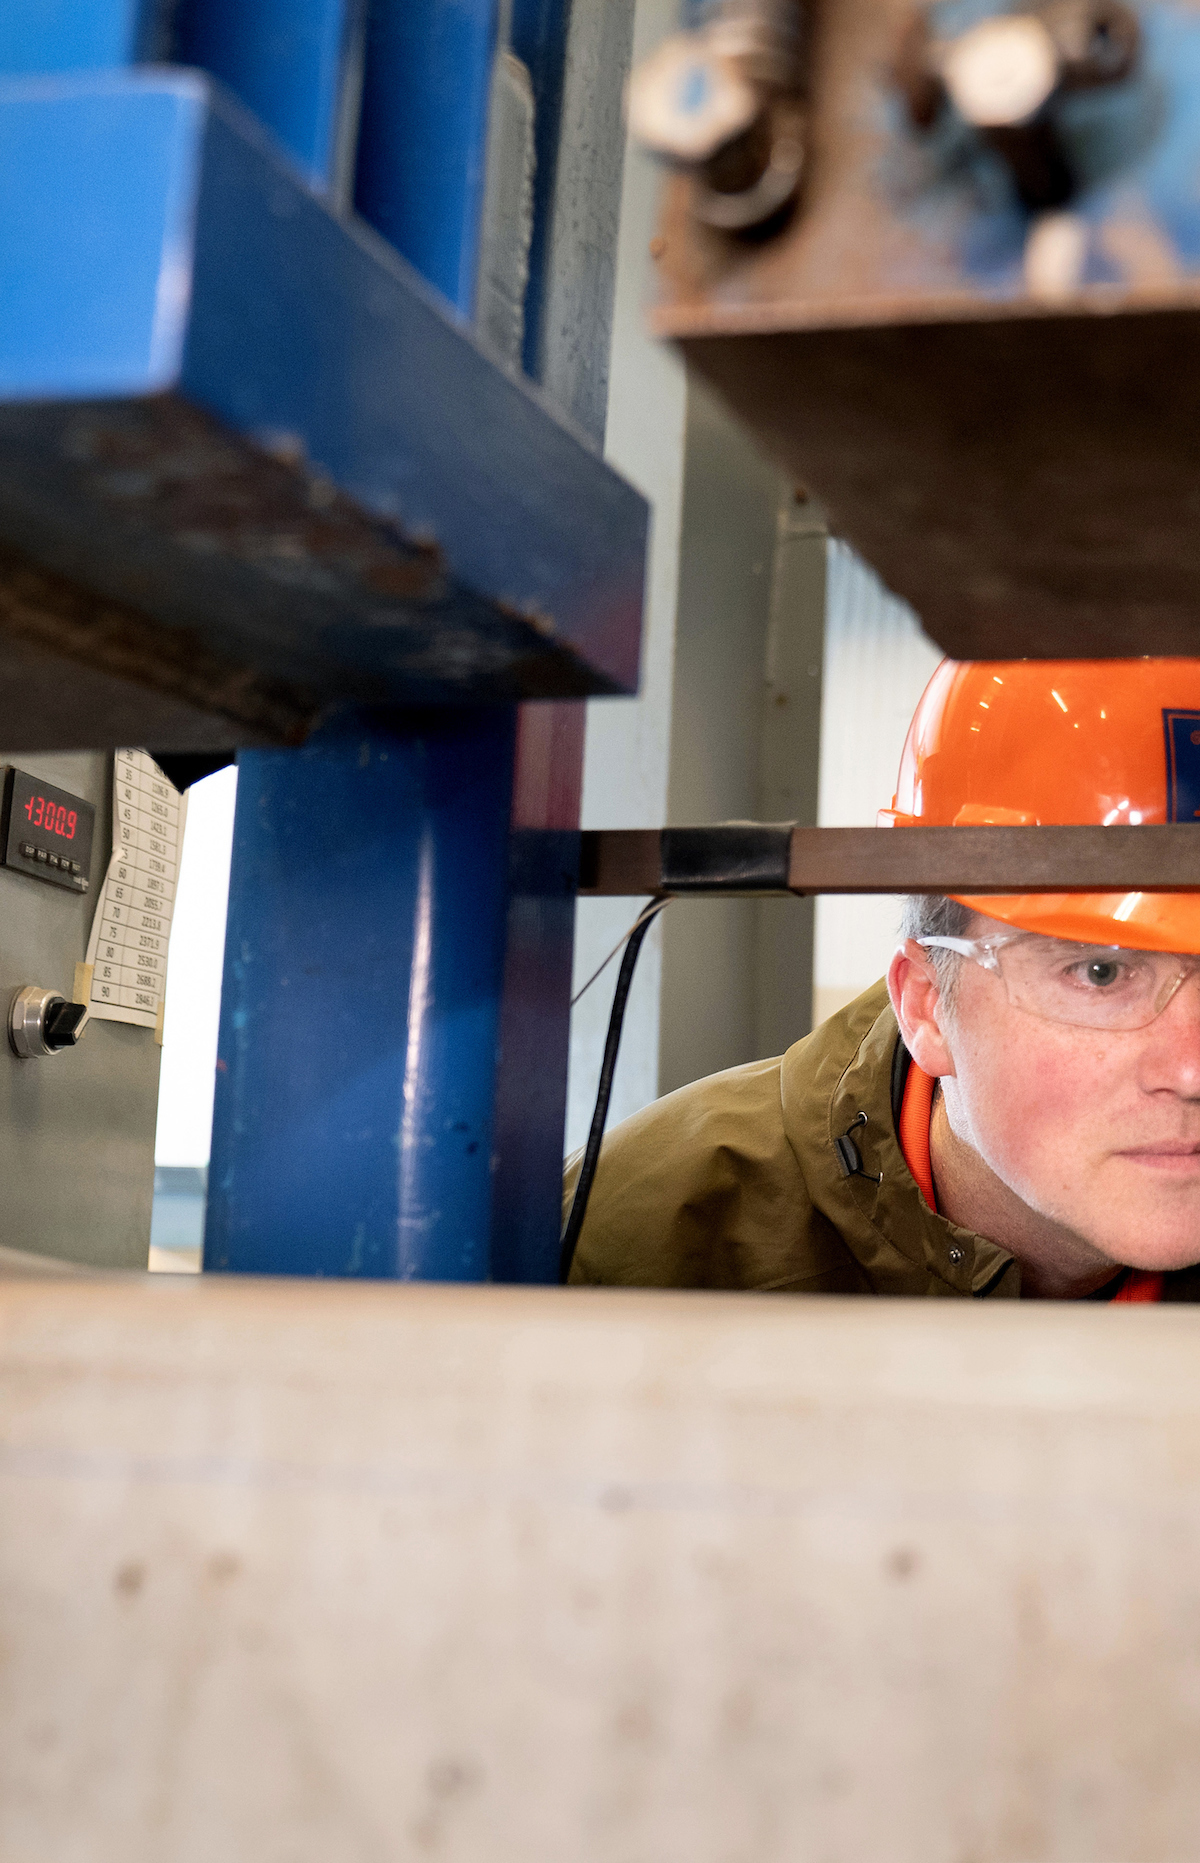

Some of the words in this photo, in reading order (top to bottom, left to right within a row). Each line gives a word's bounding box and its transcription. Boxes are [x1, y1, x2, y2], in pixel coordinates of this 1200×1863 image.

[126, 750, 133, 761] 30
[126, 768, 132, 780] 35
[125, 789, 131, 800] 40
[124, 808, 131, 820] 45
[122, 828, 130, 840] 50
[119, 867, 126, 879] 60
[115, 887, 123, 899] 65
[113, 906, 120, 918] 70
[110, 926, 117, 938] 75
[139, 935, 159, 949] 2371.9
[106, 947, 114, 958] 80
[103, 966, 111, 978] 85
[102, 986, 110, 998] 90
